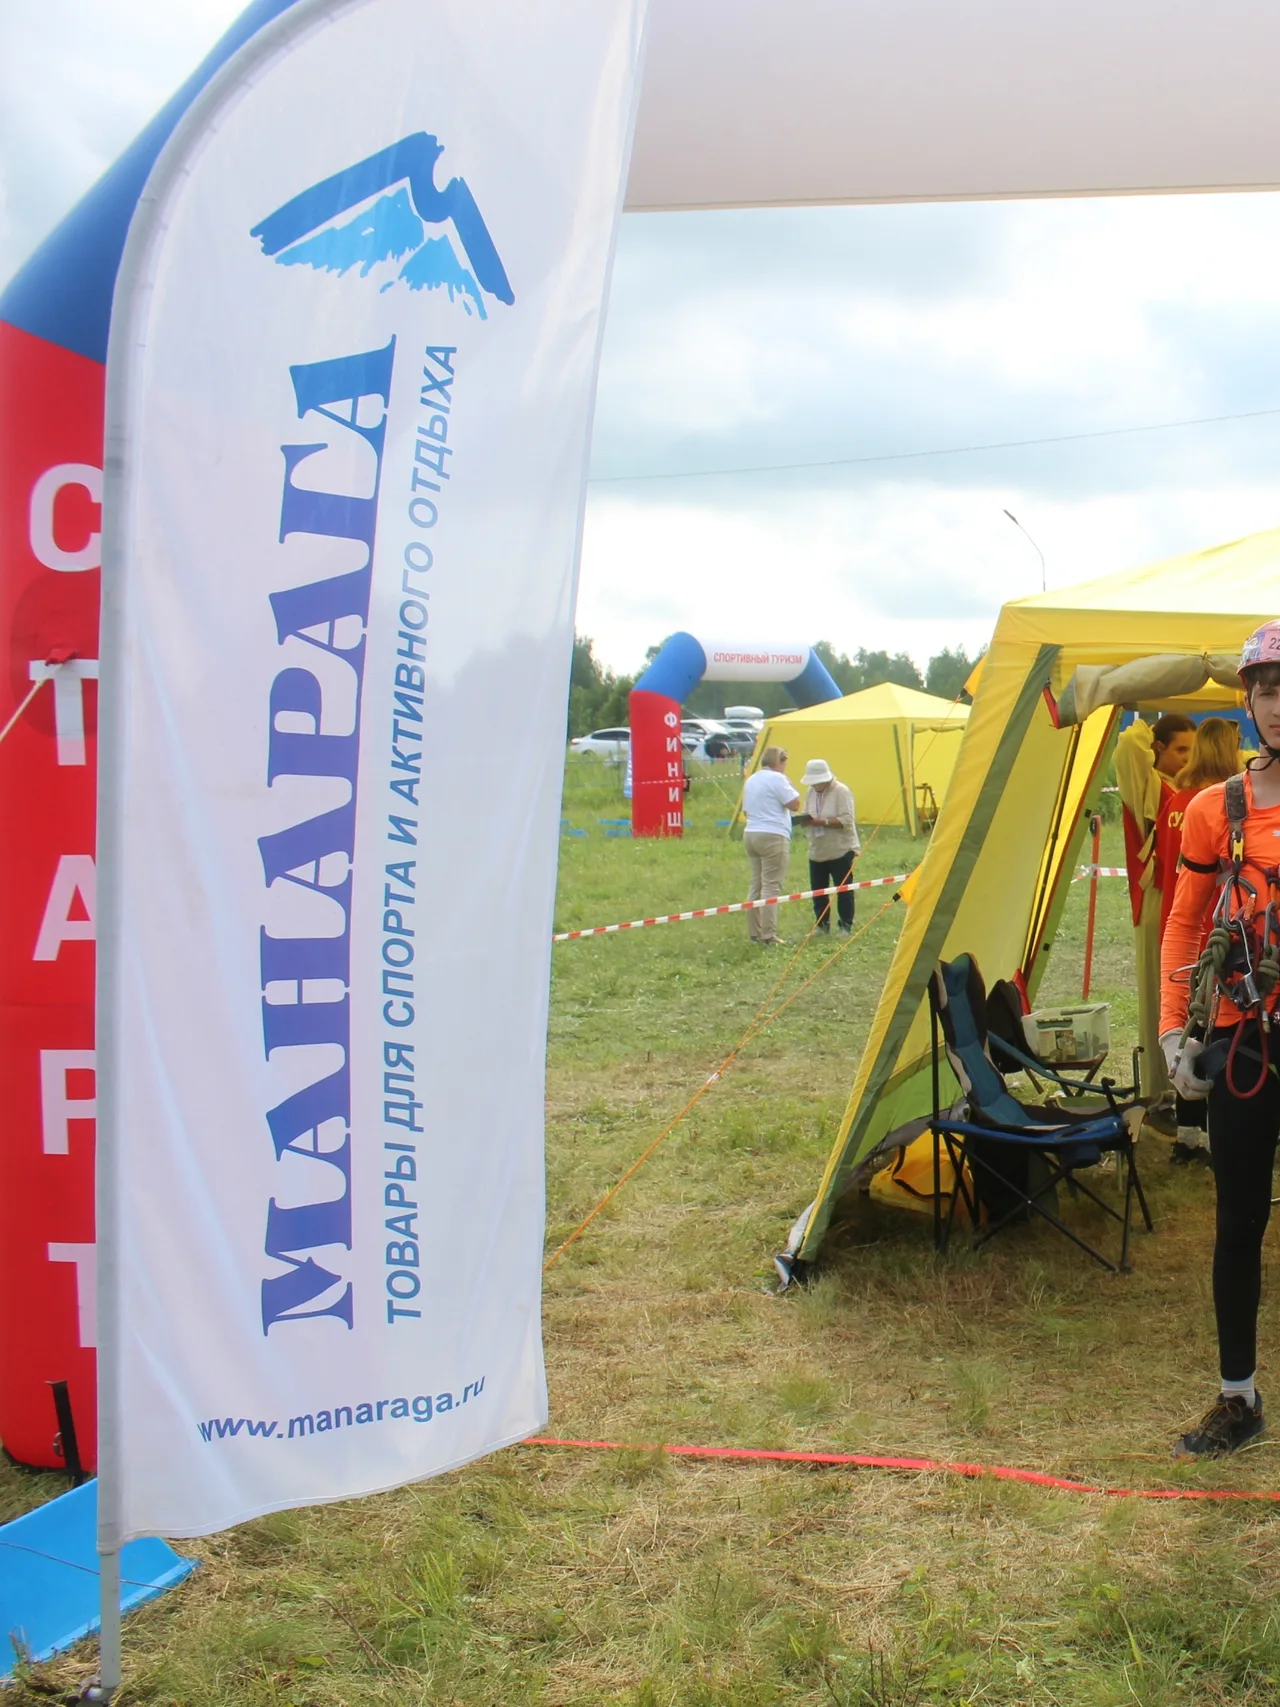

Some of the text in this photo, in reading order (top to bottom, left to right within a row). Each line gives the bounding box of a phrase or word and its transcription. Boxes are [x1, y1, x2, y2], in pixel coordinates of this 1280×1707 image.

[713, 651, 802, 664] СПОРТИВНЫЙ ТУРИЗМ
[664, 711, 681, 827] ФИНИШ
[257, 333, 397, 1336] МАНАРАГА
[381, 345, 458, 1325] ТОВАРЫ ДЛЯ СПОРТА И АКТИВНОГО ОТДЫХА
[197, 1376, 486, 1443] www.manaraga.ru
